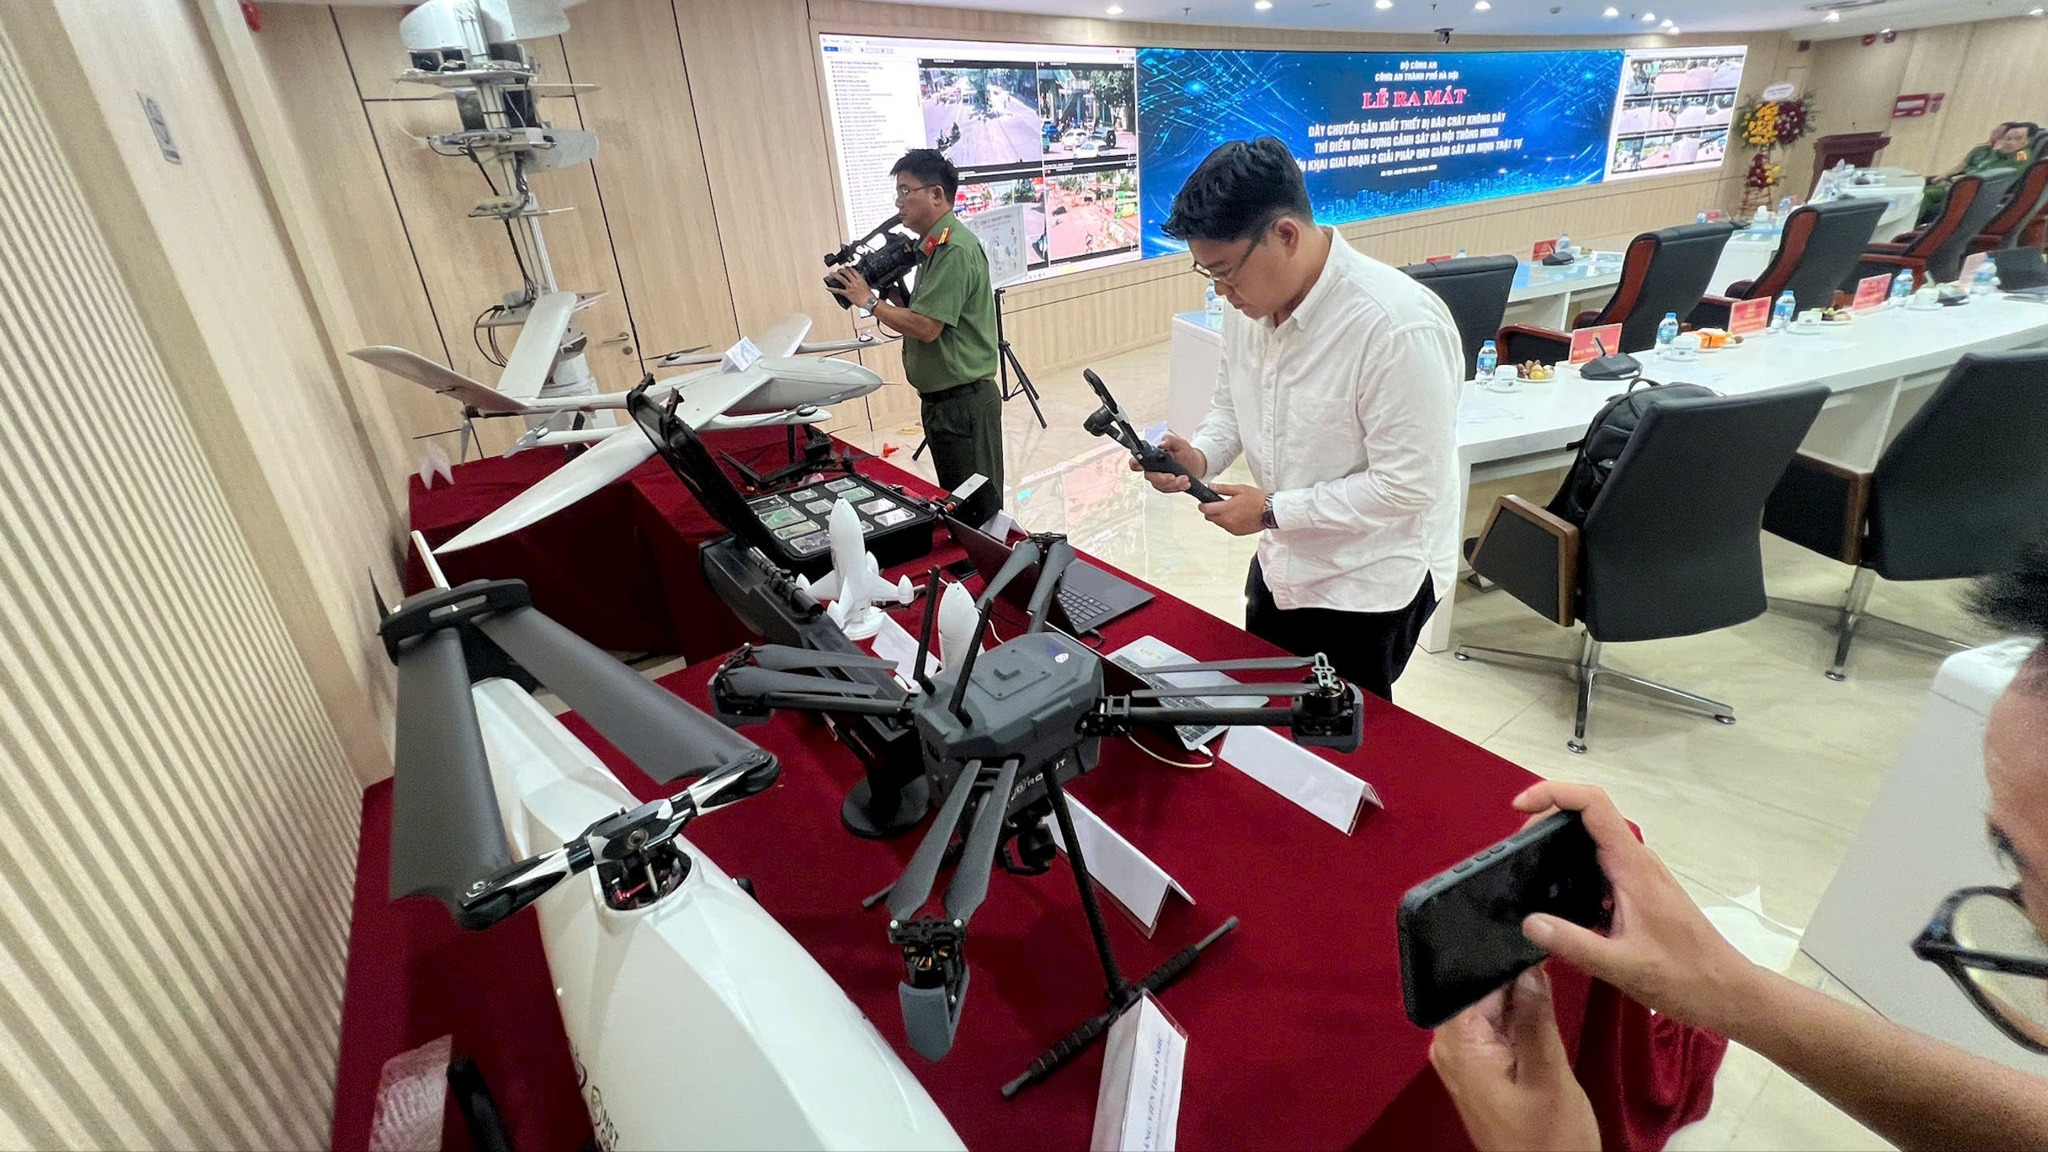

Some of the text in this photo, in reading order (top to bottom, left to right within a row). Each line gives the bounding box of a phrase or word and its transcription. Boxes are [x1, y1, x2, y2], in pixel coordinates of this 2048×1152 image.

[1361, 87, 1389, 109] LỄ
[1393, 90, 1421, 107] RA
[1308, 123, 1326, 138] DÂY
[1378, 117, 1399, 132] XUẤT
[1400, 116, 1421, 130] THIẾT
[1422, 118, 1430, 130] BỊ
[1431, 116, 1446, 128] BÁO
[1446, 114, 1466, 126] CHÁY
[1466, 113, 1491, 125] KHÔNG
[1491, 111, 1507, 123] DÂY
[1352, 135, 1369, 149] ỨNG
[1369, 135, 1392, 150] DỤNG
[1414, 131, 1430, 144] SÁT
[1430, 130, 1441, 143] HÀ
[1456, 127, 1479, 140] THÔNG
[1307, 158, 1328, 171] KHAI
[1329, 156, 1347, 169] GIAI
[1370, 155, 1377, 165] 2
[1395, 148, 1415, 162] PHÁP
[1450, 142, 1466, 155] SÁT
[1465, 142, 1476, 153] AN
